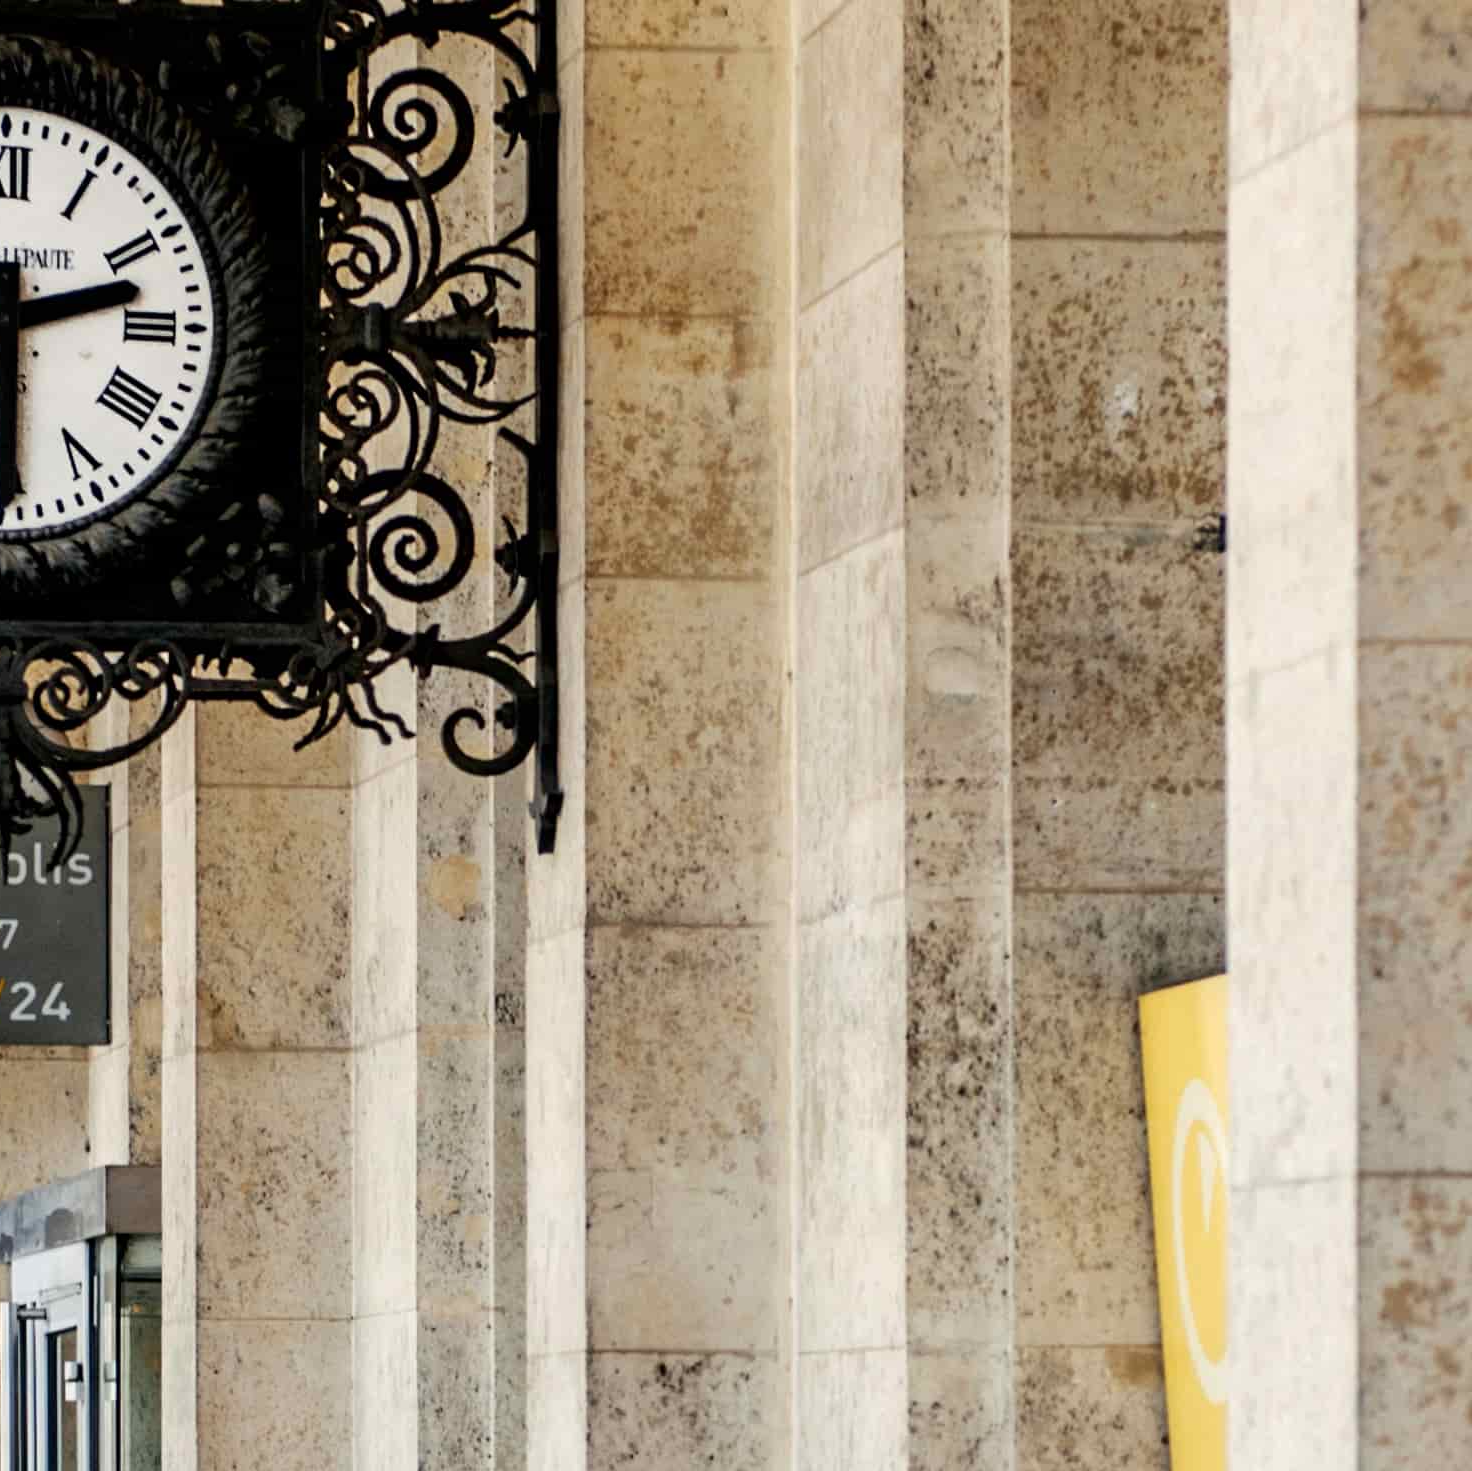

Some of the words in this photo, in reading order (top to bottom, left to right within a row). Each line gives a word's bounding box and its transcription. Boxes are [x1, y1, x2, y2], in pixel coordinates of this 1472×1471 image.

[103, 228, 161, 276] II
[122, 308, 177, 346] III
[96, 365, 163, 432] IIII
[61, 427, 103, 481] V
